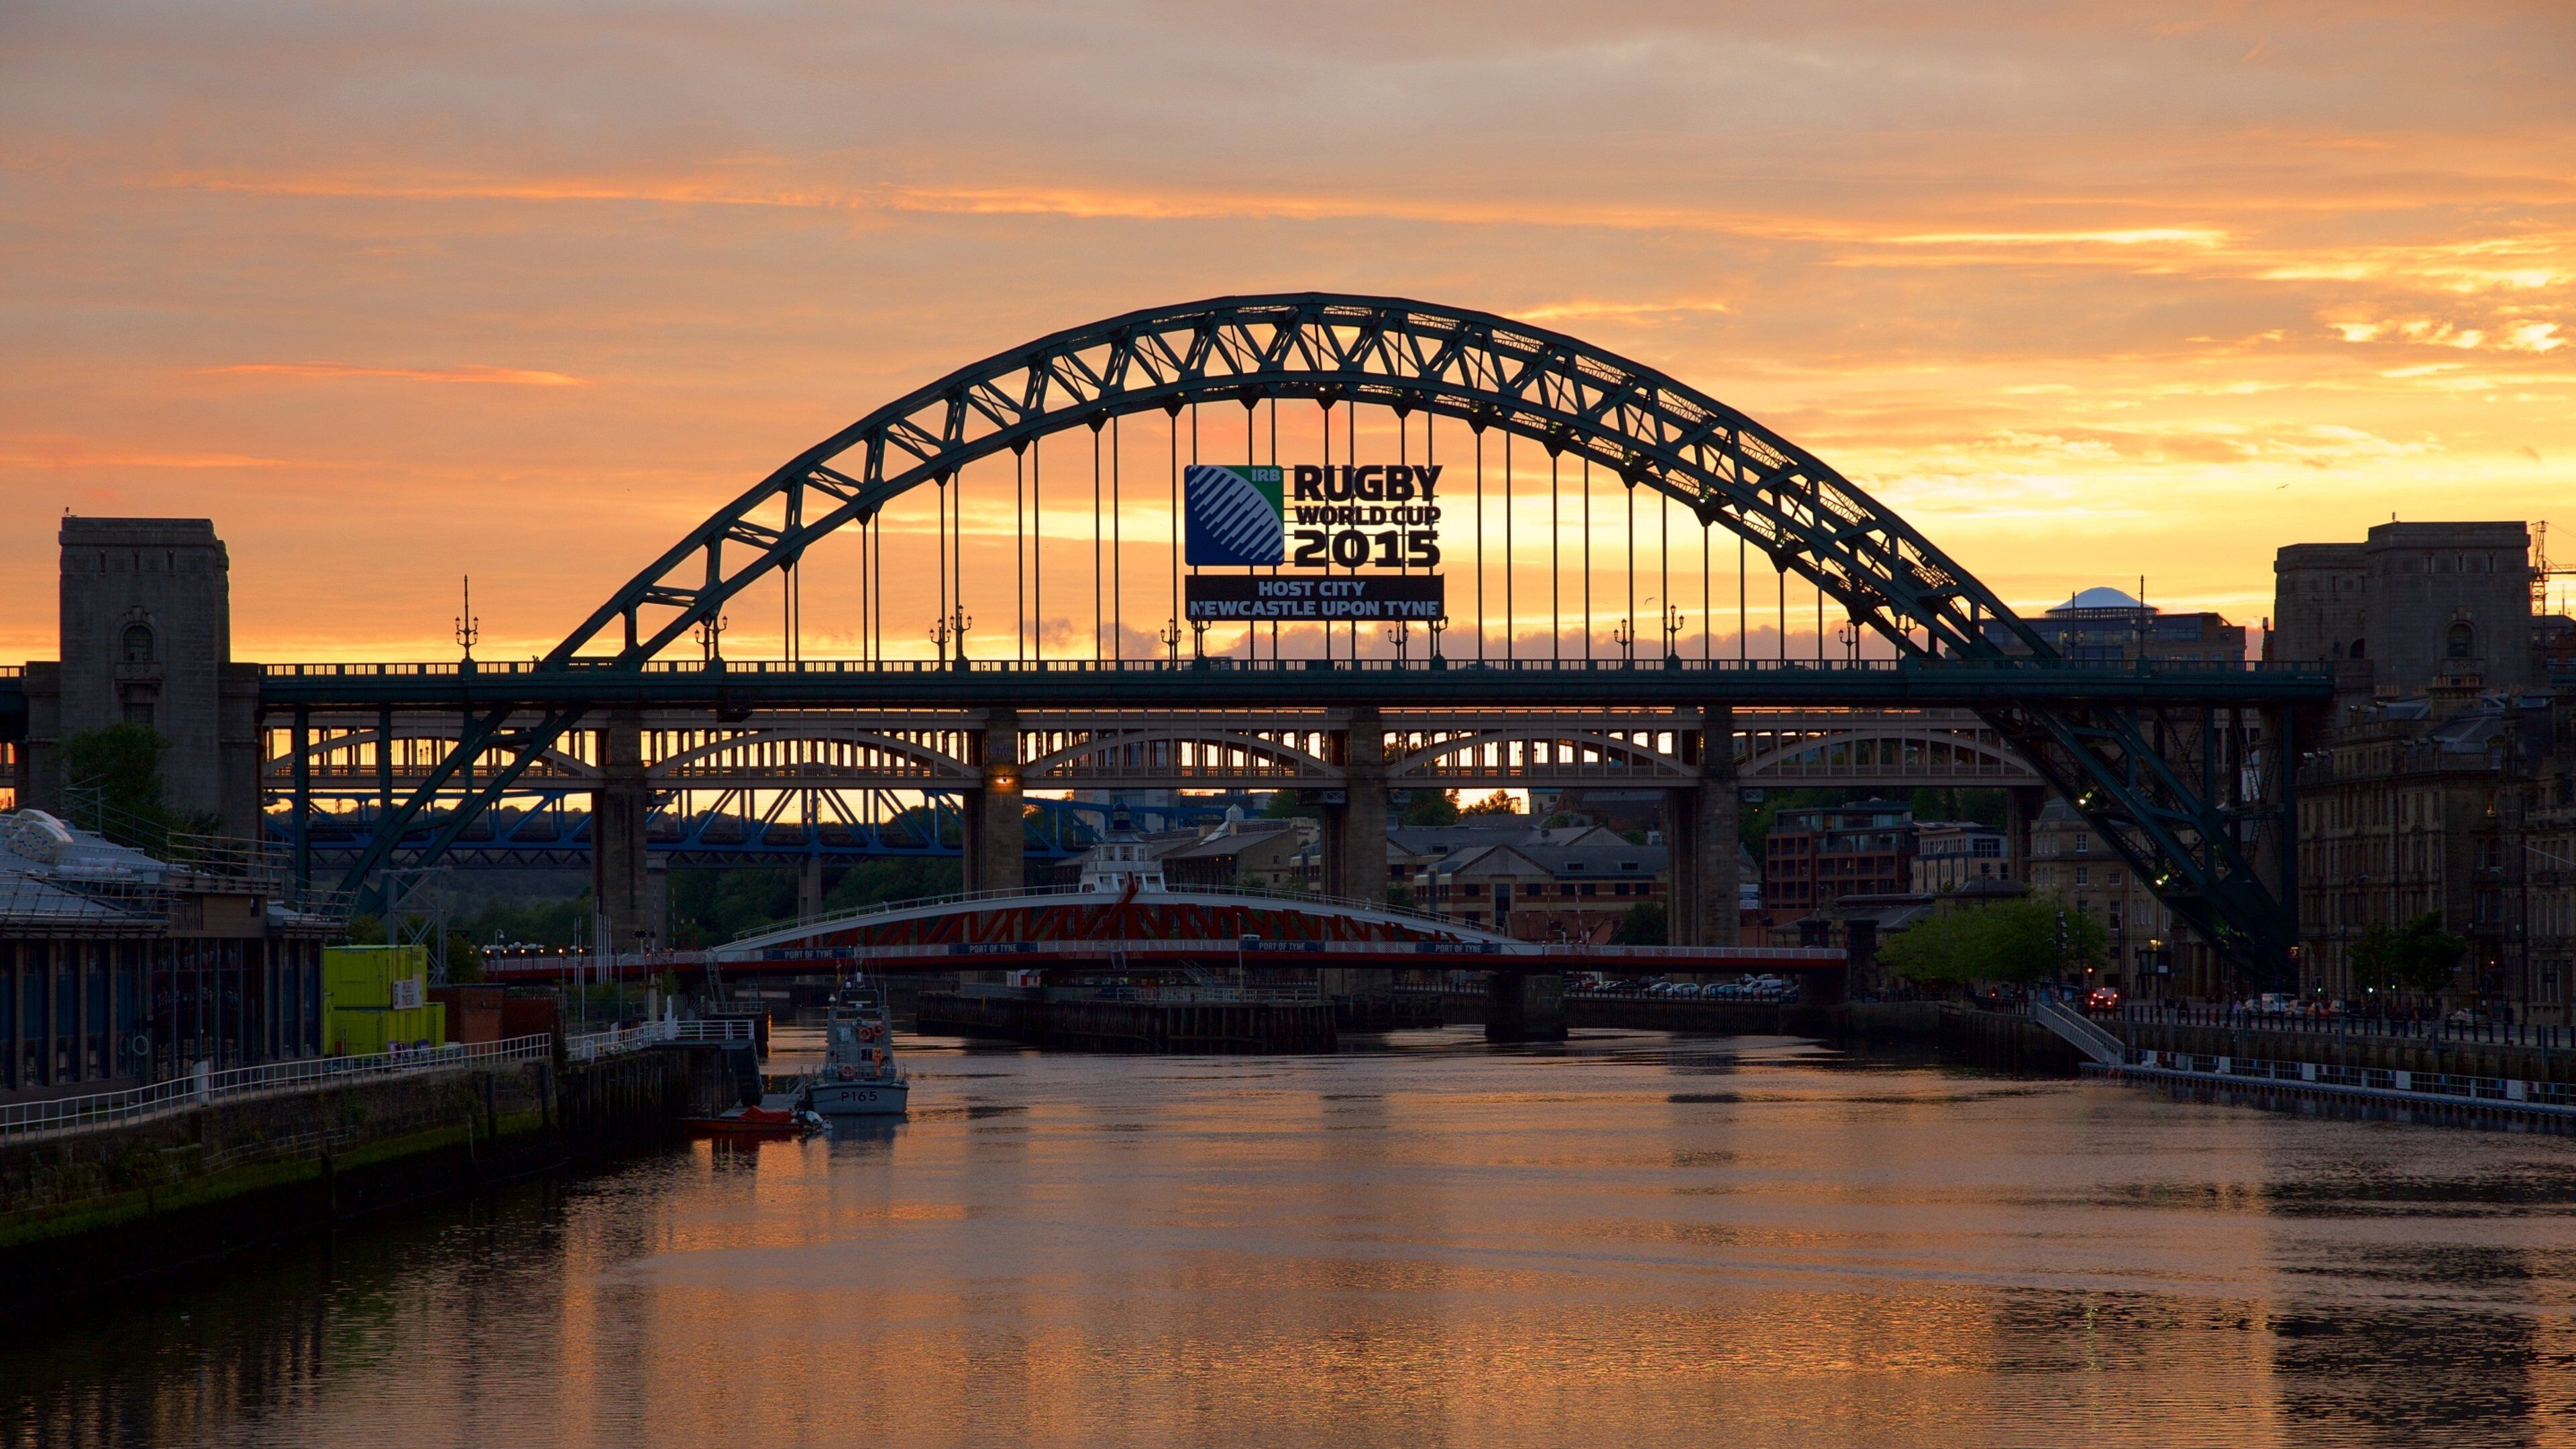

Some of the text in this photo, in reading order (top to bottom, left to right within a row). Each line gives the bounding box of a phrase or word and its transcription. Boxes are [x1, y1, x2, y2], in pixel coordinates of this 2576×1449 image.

[1251, 469, 1281, 482] IRB
[1294, 464, 1444, 502] RUGBY
[1295, 506, 1442, 526] WORLD CUP
[1294, 529, 1441, 568] 2015
[1258, 581, 1366, 596] HOST CITY
[1189, 600, 1439, 616] NEWCASTLE UPON TYNE
[969, 944, 1017, 953] PORT OF TYNE
[1258, 942, 1306, 951] PORT OF TYNE
[1436, 945, 1482, 953] PORT OF TYNE
[784, 949, 833, 959] PORT OF TYNE
[841, 1091, 877, 1102] P165
